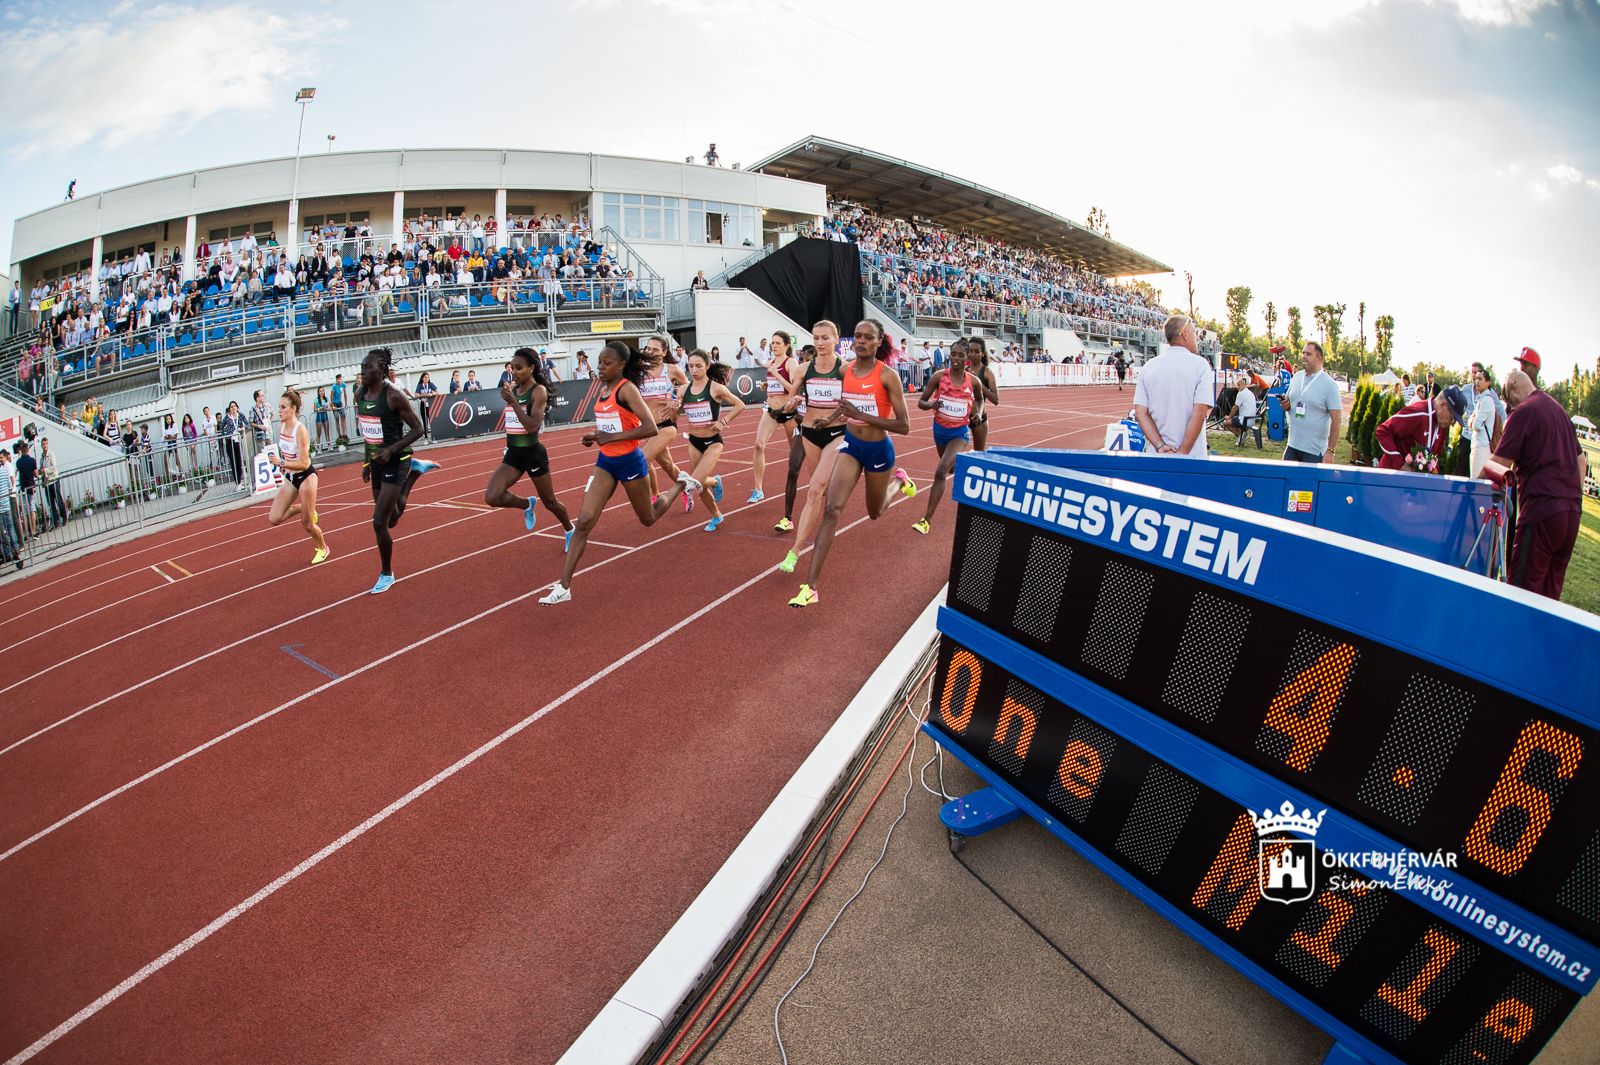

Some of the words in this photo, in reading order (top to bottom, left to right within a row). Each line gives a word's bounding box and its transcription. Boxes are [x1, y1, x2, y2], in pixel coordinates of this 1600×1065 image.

[1229, 354, 1239, 369] 4
[814, 388, 833, 397] PLIŚ
[1108, 433, 1124, 451] 4
[257, 461, 271, 485] 5
[963, 466, 1267, 585] ONLINESYSTEM
[940, 650, 1103, 799] One
